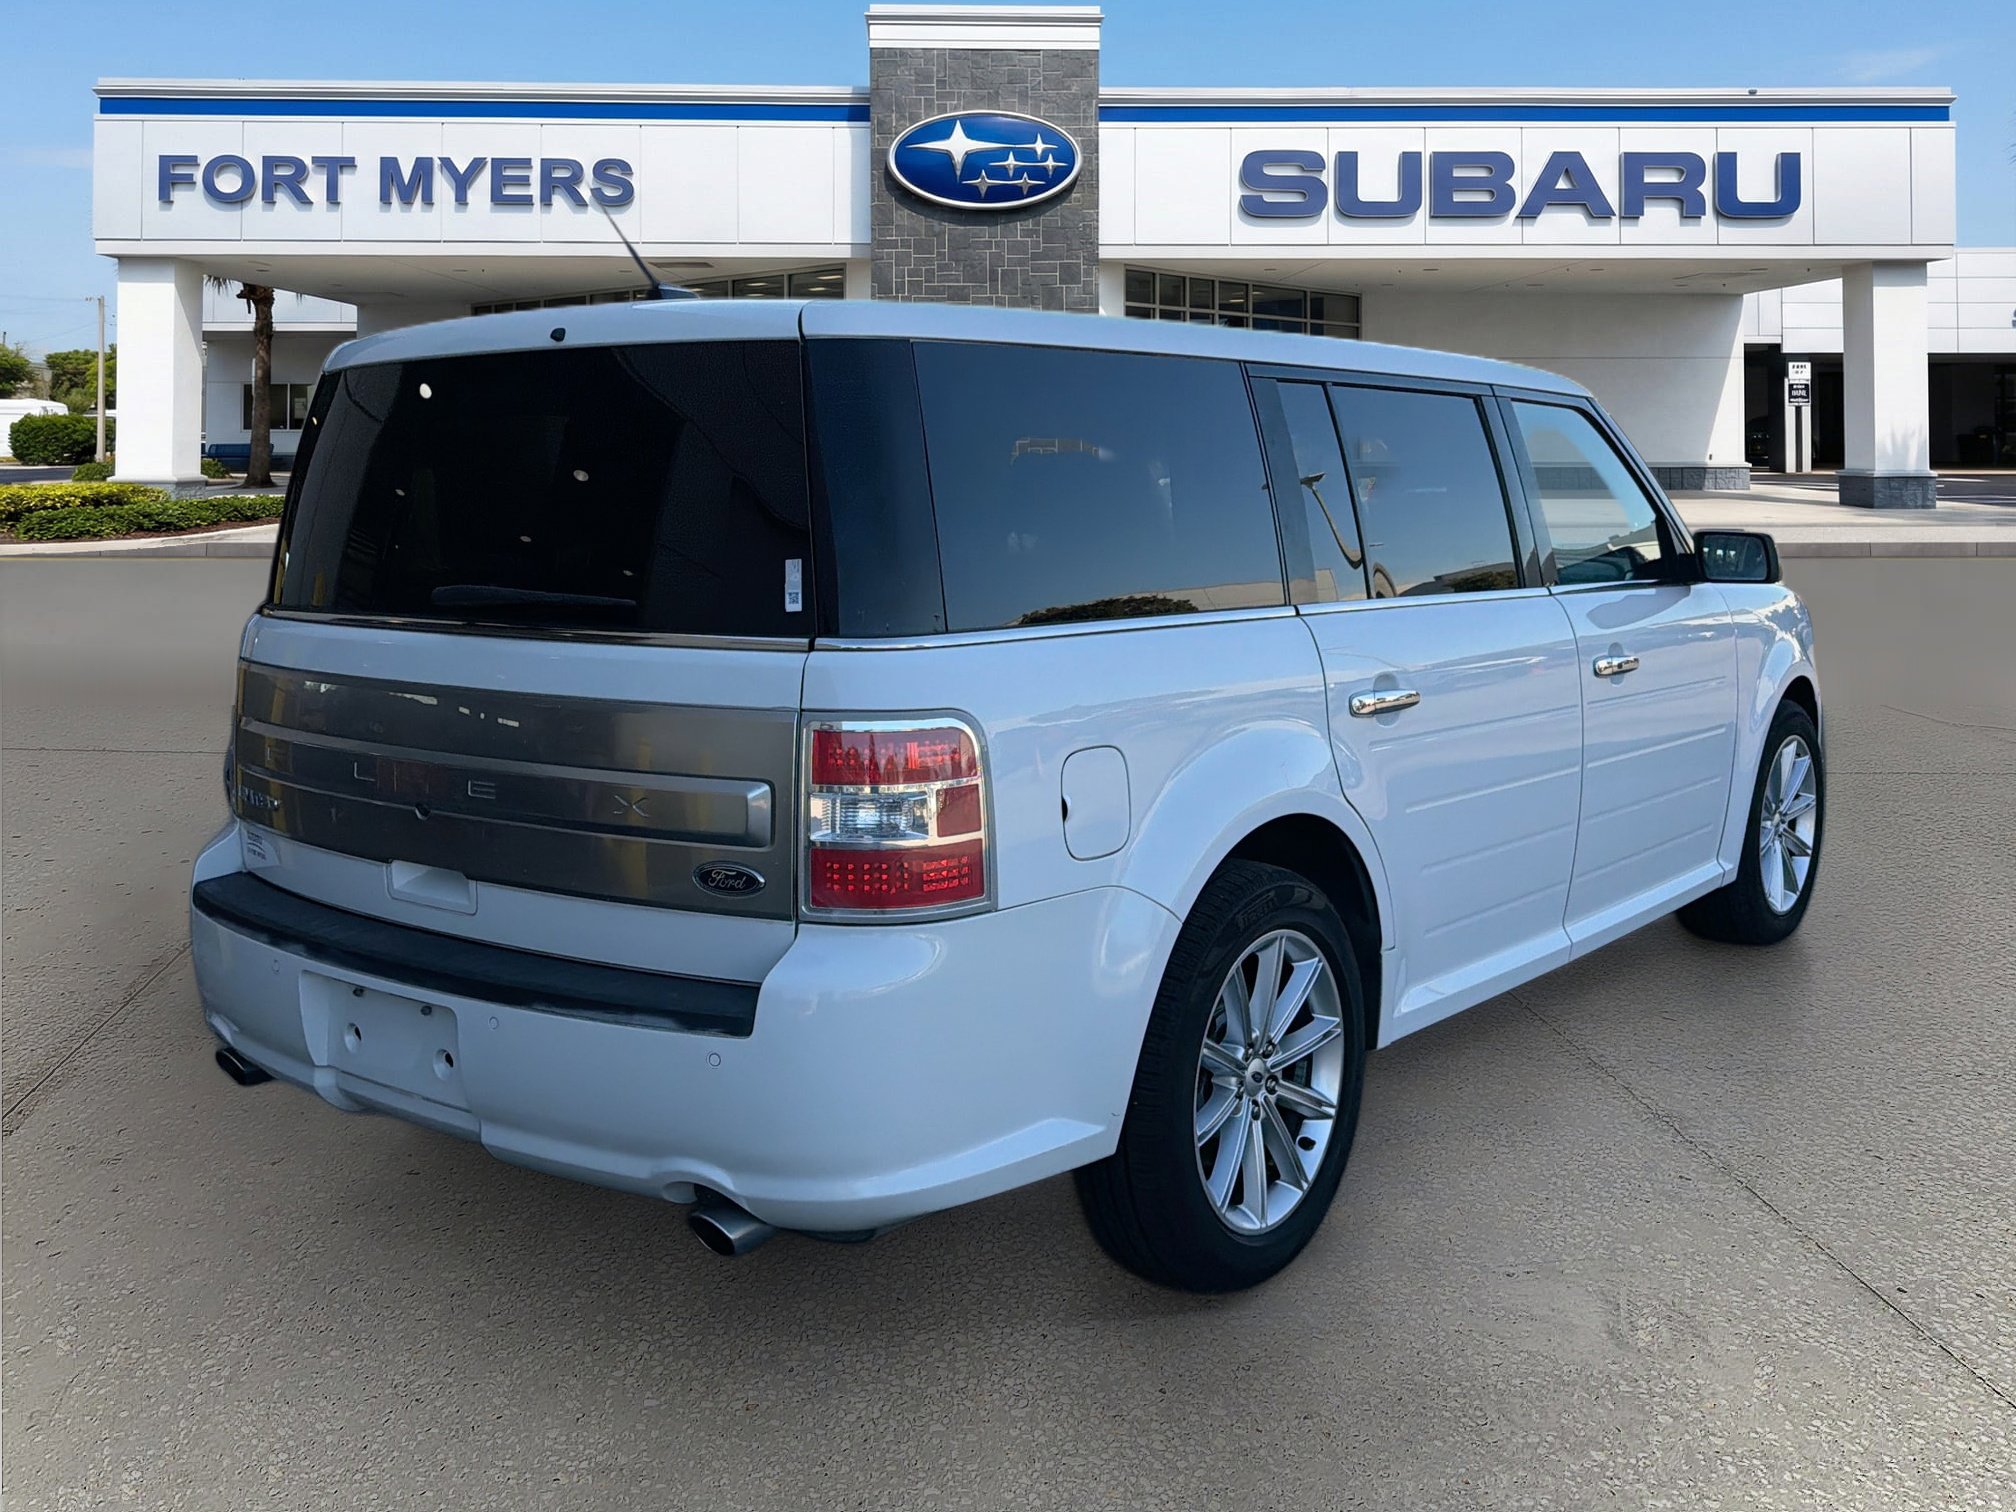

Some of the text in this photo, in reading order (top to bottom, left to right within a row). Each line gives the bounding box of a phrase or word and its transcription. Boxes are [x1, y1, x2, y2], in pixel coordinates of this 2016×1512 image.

[158, 153, 635, 206] FORT MYERS
[1239, 149, 1802, 219] SUBARU
[707, 868, 748, 890] Ford
